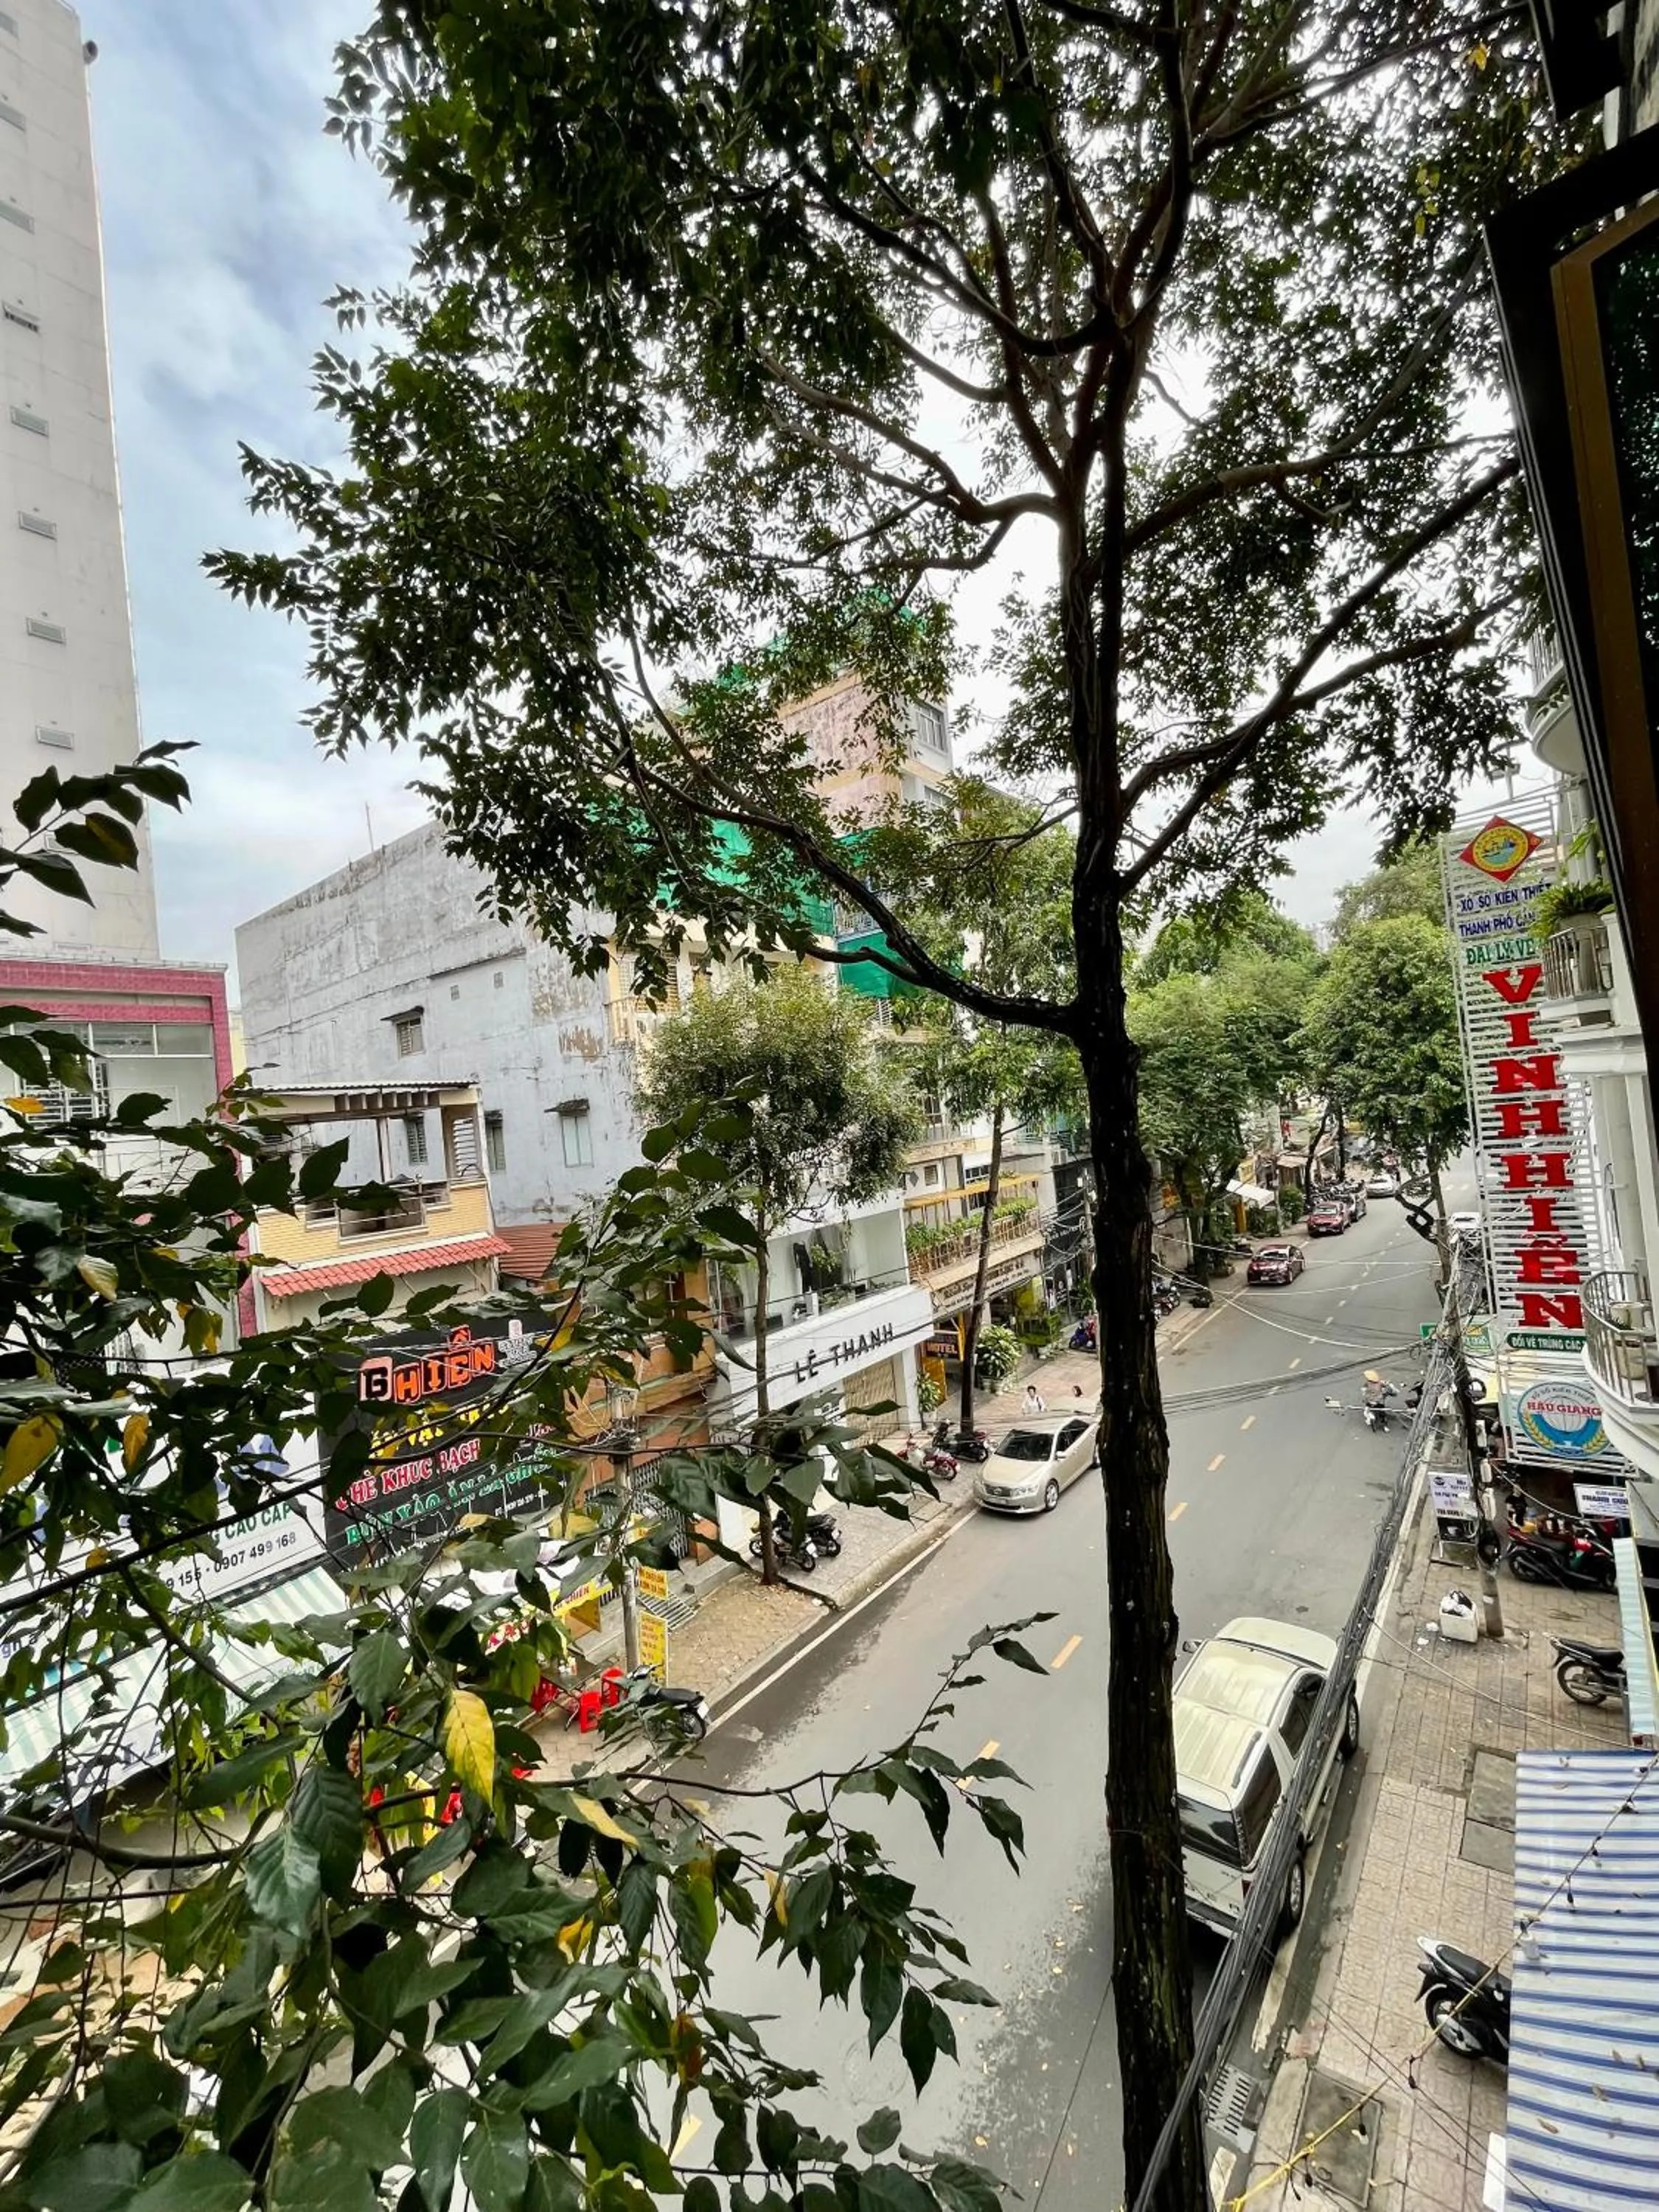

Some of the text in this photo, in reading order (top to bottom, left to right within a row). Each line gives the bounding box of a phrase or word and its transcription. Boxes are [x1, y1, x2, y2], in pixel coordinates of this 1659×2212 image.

[795, 1322, 894, 1383] LÊ THANH
[1557, 1404, 1602, 1416] GIANG
[214, 1551, 246, 1573] 0907
[250, 1540, 273, 1559] 499
[275, 1531, 296, 1551] 168
